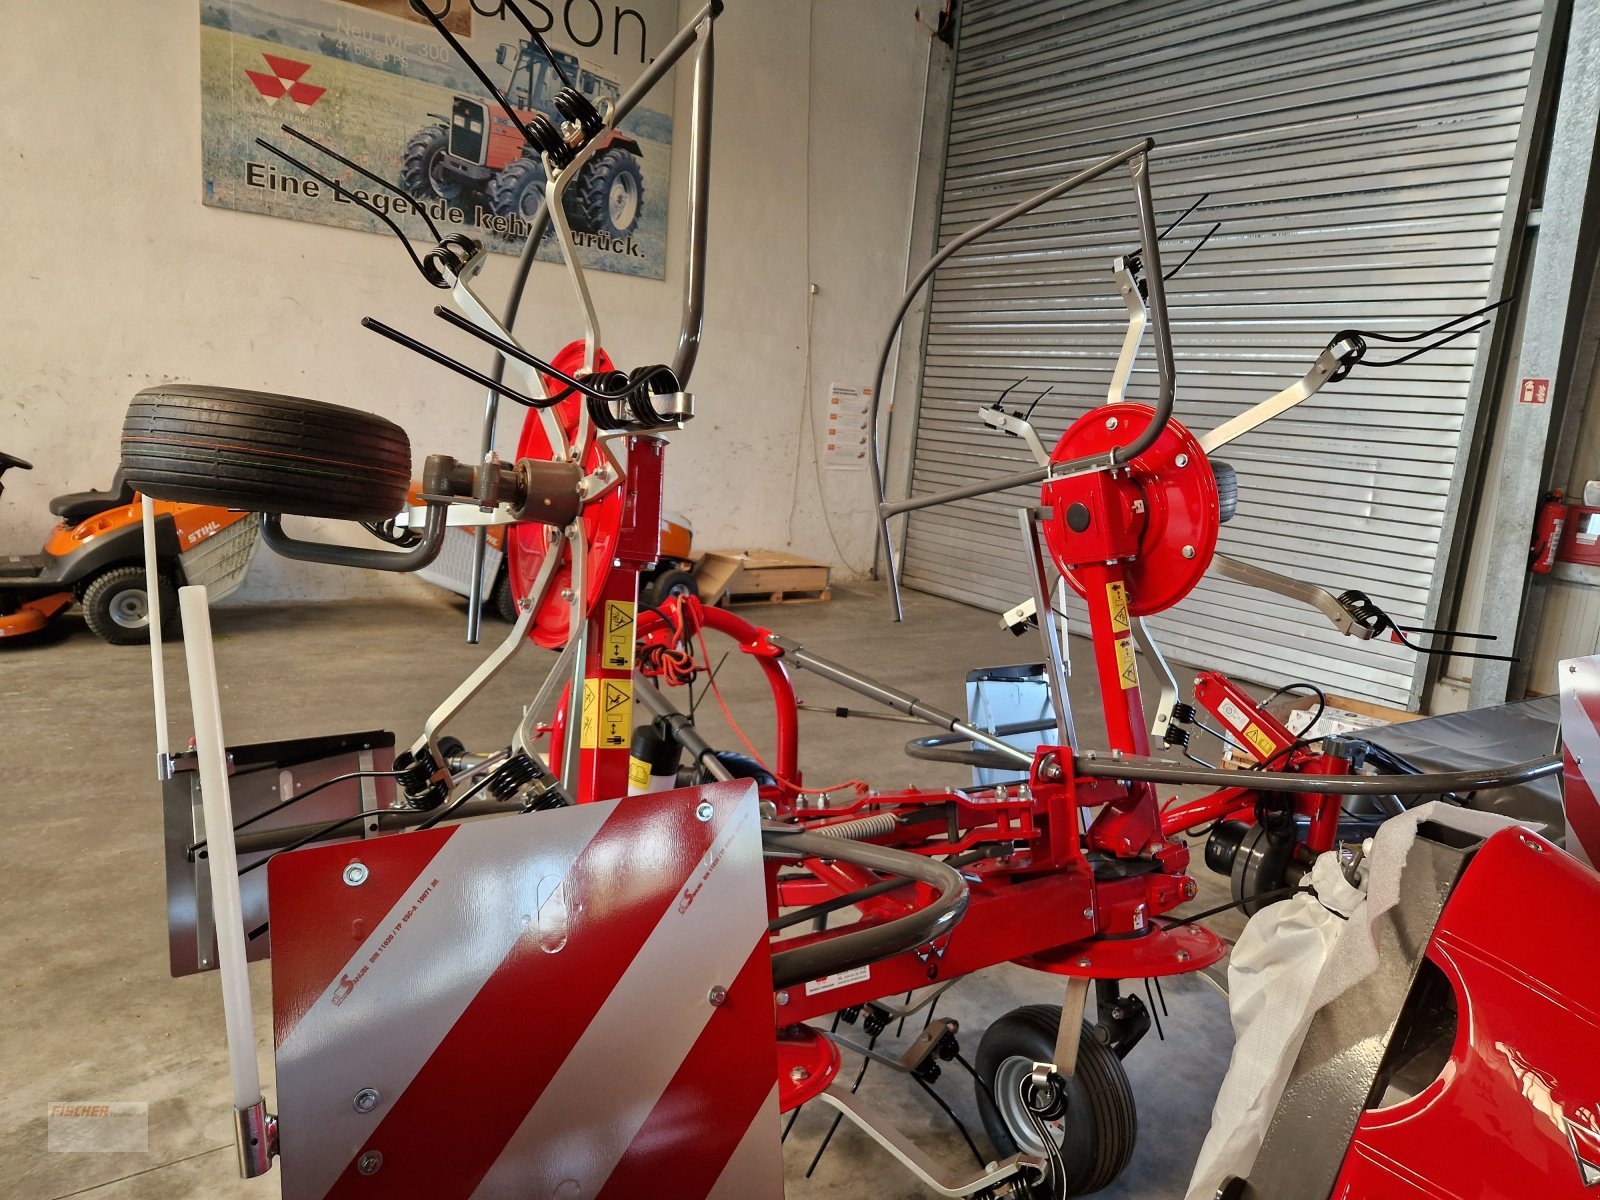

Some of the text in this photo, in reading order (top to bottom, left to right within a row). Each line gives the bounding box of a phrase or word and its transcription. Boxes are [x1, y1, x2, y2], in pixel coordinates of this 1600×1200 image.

[336, 19, 373, 41] Neu
[418, 42, 450, 63] 300
[246, 162, 320, 198] Eine
[333, 179, 465, 224] Legende
[557, 230, 646, 258] urück.
[187, 520, 221, 544] STIHL
